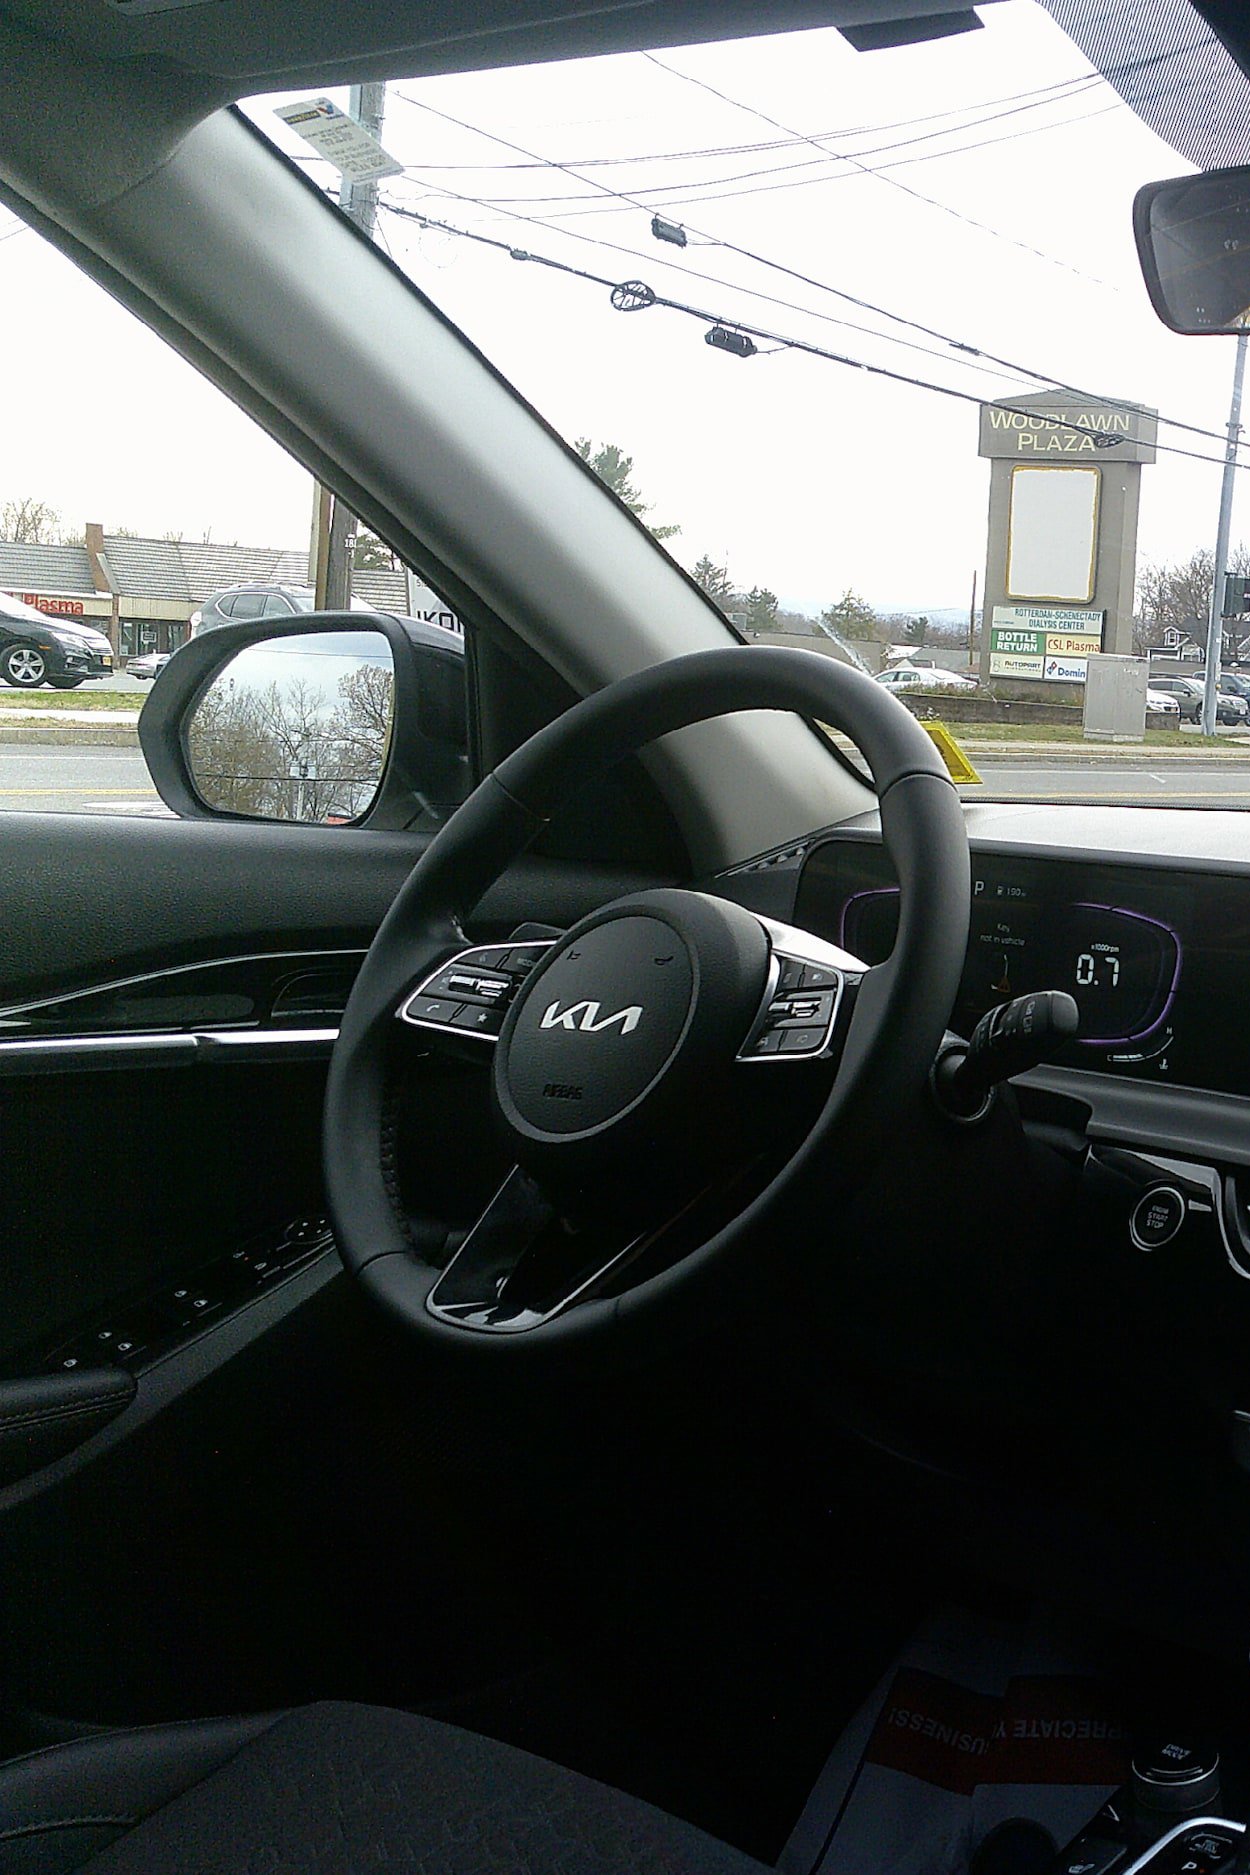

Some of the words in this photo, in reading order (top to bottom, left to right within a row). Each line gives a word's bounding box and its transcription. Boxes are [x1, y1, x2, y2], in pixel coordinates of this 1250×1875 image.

[989, 411, 1130, 431] WOODLAWN
[1017, 433, 1097, 452] PLAZA
[1058, 621, 1085, 631] CENTER
[997, 630, 1038, 643] BOTTLE
[996, 641, 1038, 652] RETURN
[1047, 638, 1064, 650] CSL
[1066, 640, 1101, 653] Plasma
[1057, 667, 1086, 678] Domin
[974, 880, 985, 896] P
[1076, 954, 1120, 988] 0.7
[540, 999, 644, 1036] KIA
[1145, 1219, 1165, 1229] STOP
[888, 1707, 989, 1756] USINESS!
[1014, 1718, 1122, 1740] PRECIATE
